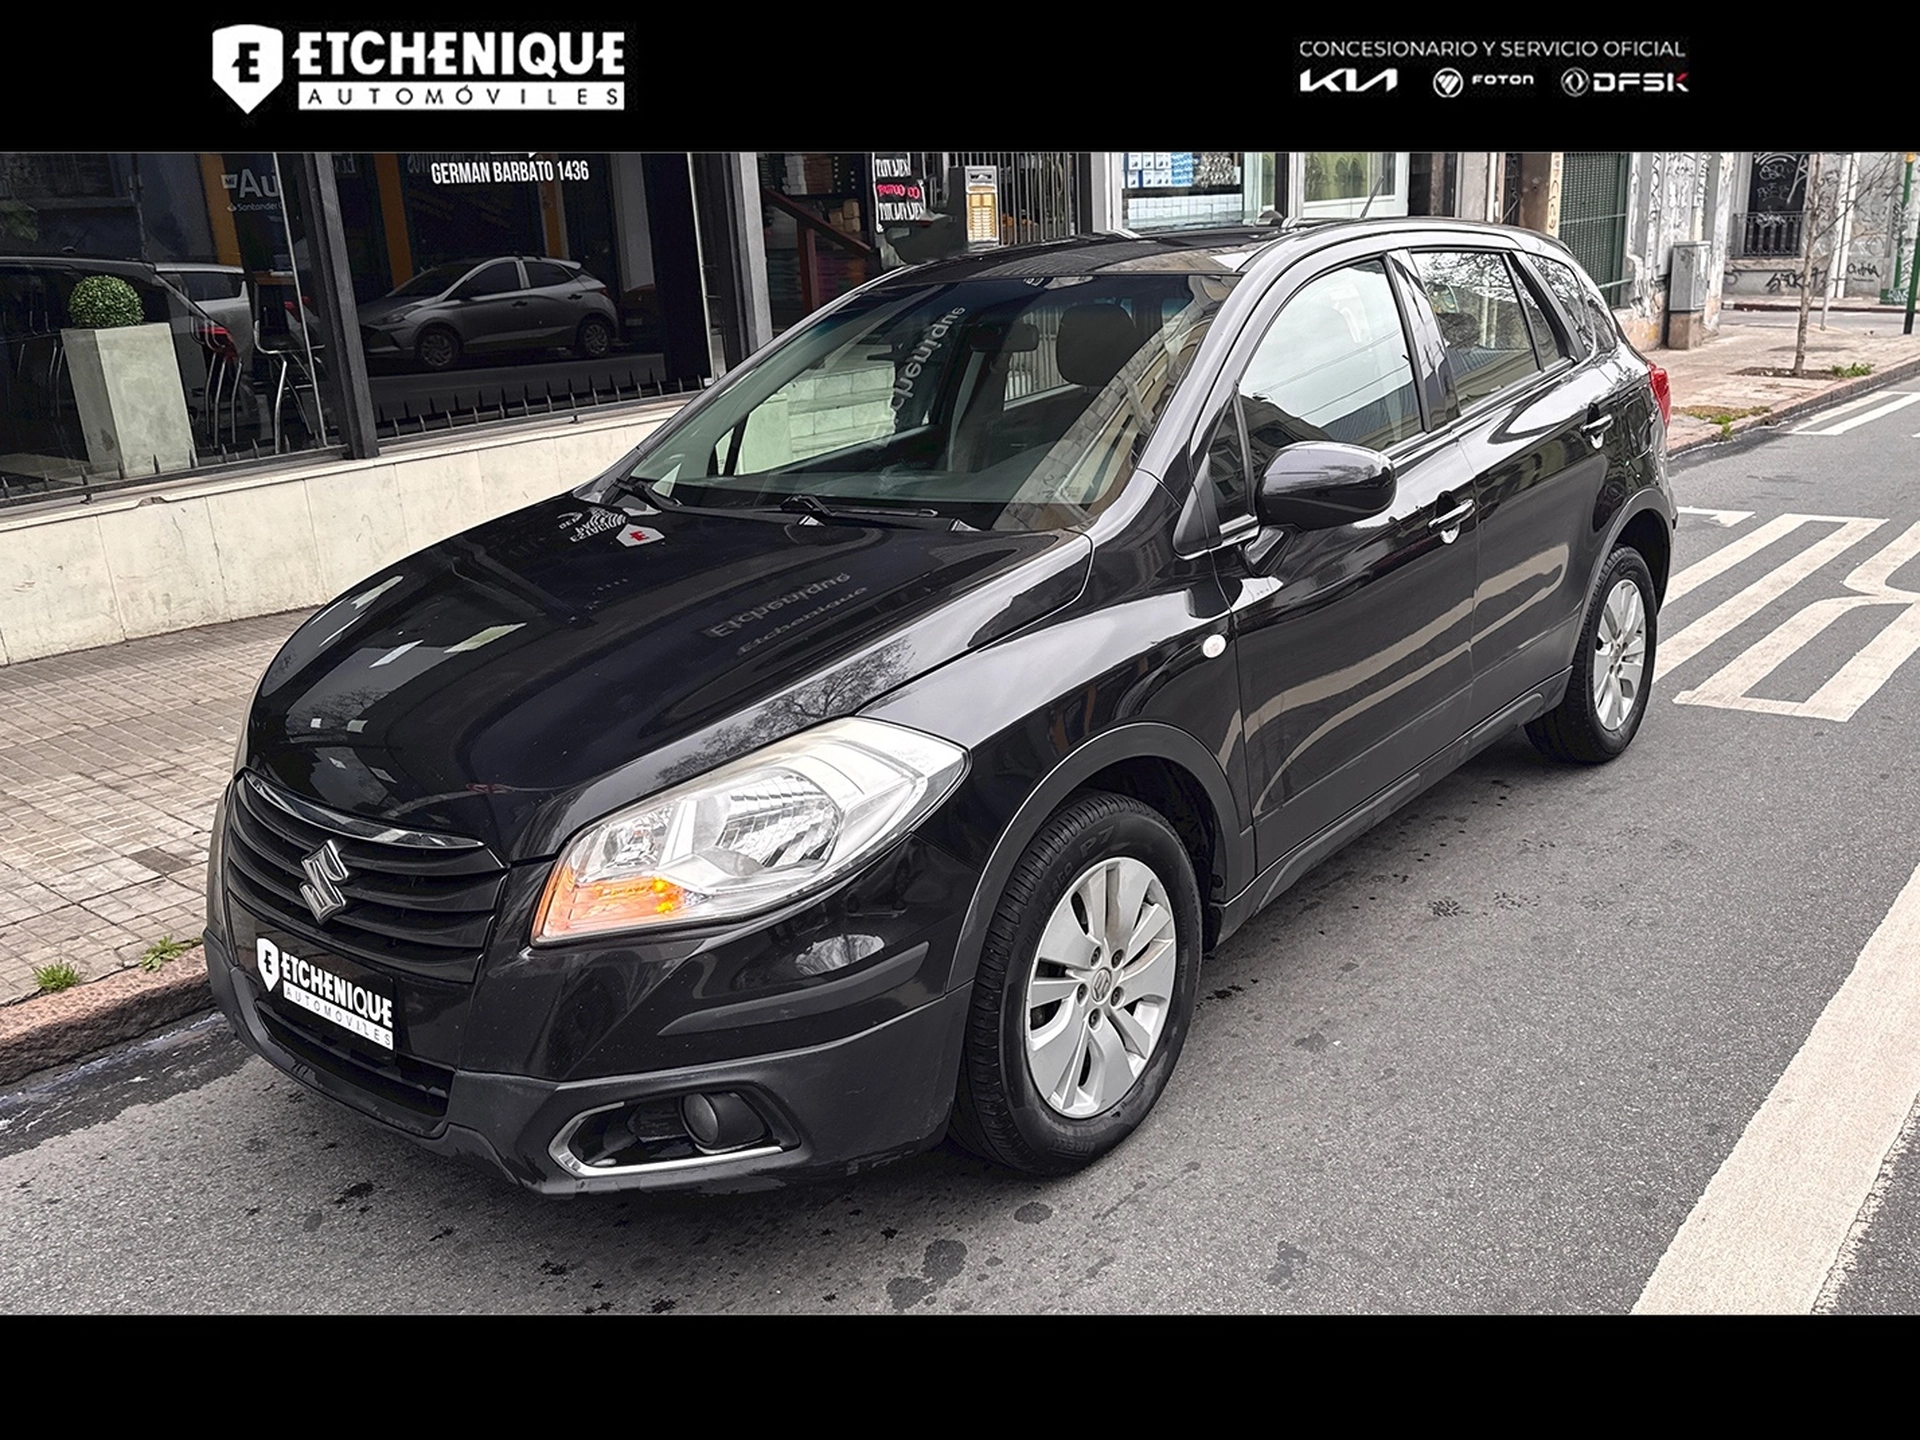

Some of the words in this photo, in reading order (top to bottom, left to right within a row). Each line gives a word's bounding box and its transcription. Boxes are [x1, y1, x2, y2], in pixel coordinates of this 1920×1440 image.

[431, 162, 491, 185] GERMAN
[493, 161, 554, 183] BARBATO
[557, 160, 590, 181] 1436
[281, 951, 393, 1029] ETCHENIQUE
